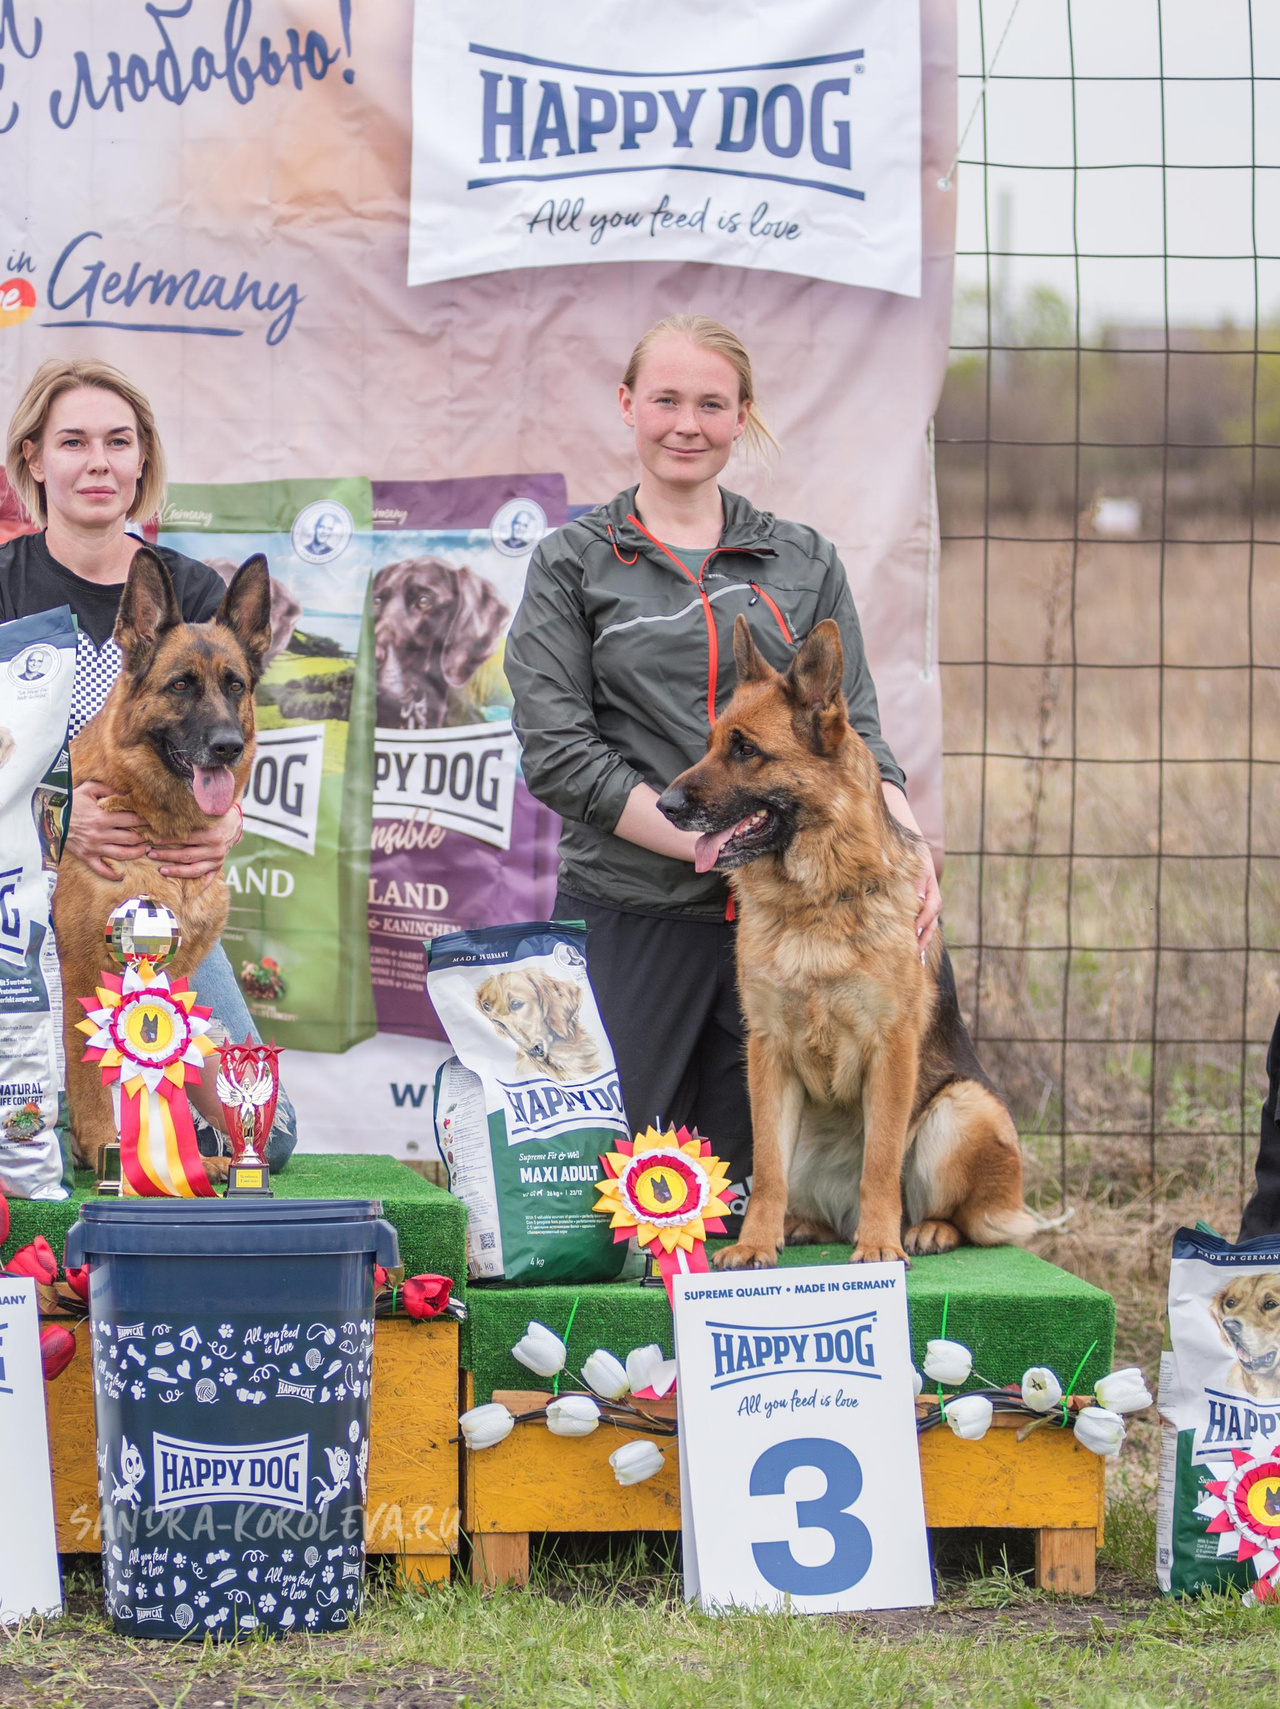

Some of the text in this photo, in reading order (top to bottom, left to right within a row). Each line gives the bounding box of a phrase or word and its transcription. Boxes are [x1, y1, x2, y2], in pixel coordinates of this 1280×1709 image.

[479, 69, 852, 171] HAPPY DOG
[527, 195, 802, 245] All you feed is love
[7, 249, 36, 275] in
[47, 232, 308, 346] Germany
[422, 750, 503, 811] DOG
[371, 807, 446, 855] nsible
[226, 865, 294, 898] AND
[368, 878, 448, 911] LAND
[587, 1081, 624, 1112] DO
[519, 1151, 580, 1163] Supreme Fit Well
[520, 1165, 599, 1183] MAXI ADULT
[530, 1257, 545, 1267] 4 kg
[684, 1279, 897, 1301] SUPREME QUALITY MADE IN GERMANY
[243, 1323, 300, 1345] All you feed
[275, 1339, 294, 1355] love
[711, 1324, 875, 1378] HAPPY DOG
[278, 1382, 315, 1400] HAPPY CAT
[737, 1389, 859, 1419] All you feed is love
[162, 1451, 300, 1493] HAPPY DOG
[749, 1438, 873, 1596] 3
[265, 1566, 316, 1589] All you feed
[290, 1583, 307, 1600] love
